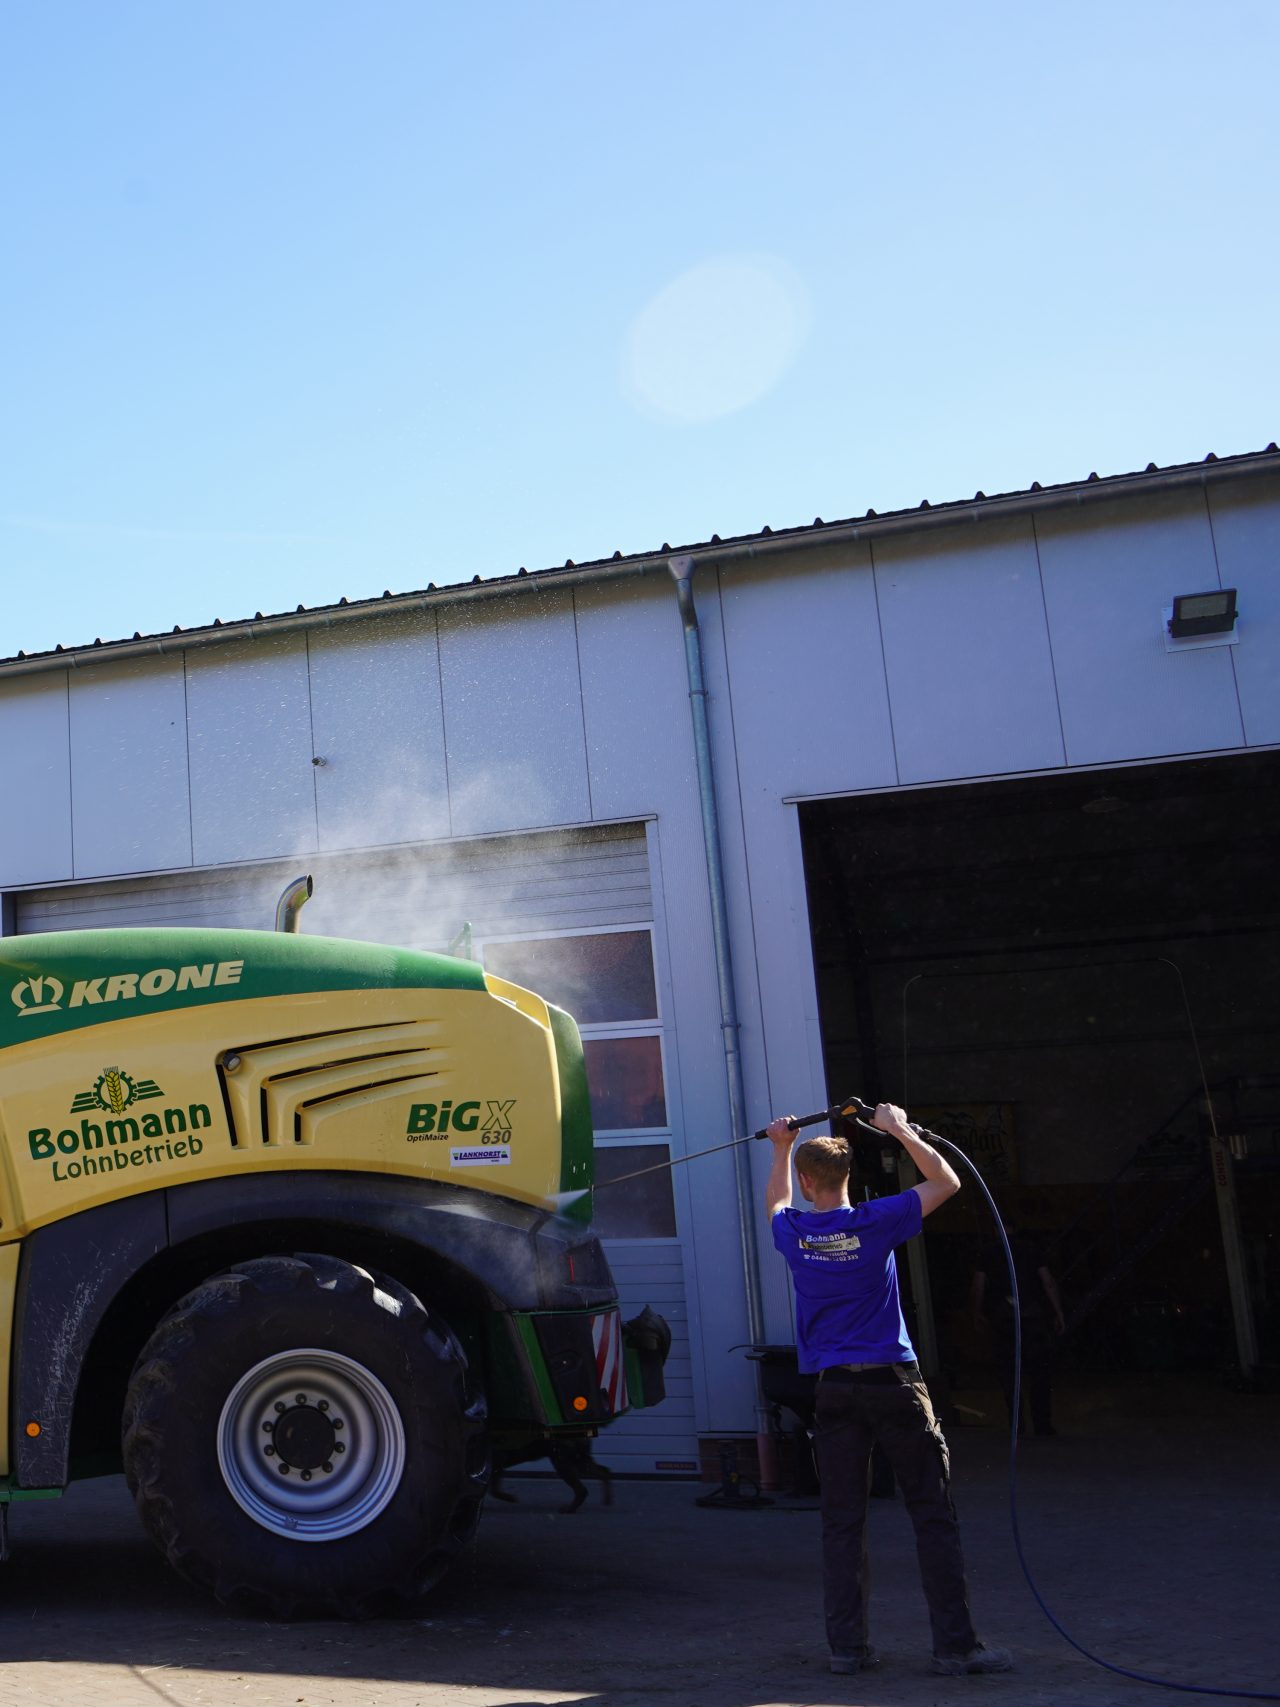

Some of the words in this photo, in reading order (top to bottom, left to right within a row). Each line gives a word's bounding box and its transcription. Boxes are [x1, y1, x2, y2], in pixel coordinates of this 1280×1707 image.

[69, 960, 244, 1008] KRONE
[28, 1103, 212, 1160] Bohmann
[406, 1133, 449, 1143] OptiMaize
[481, 1129, 512, 1145] 630
[52, 1135, 203, 1182] Lohnbetrieb
[459, 1150, 501, 1160] LANKHORST
